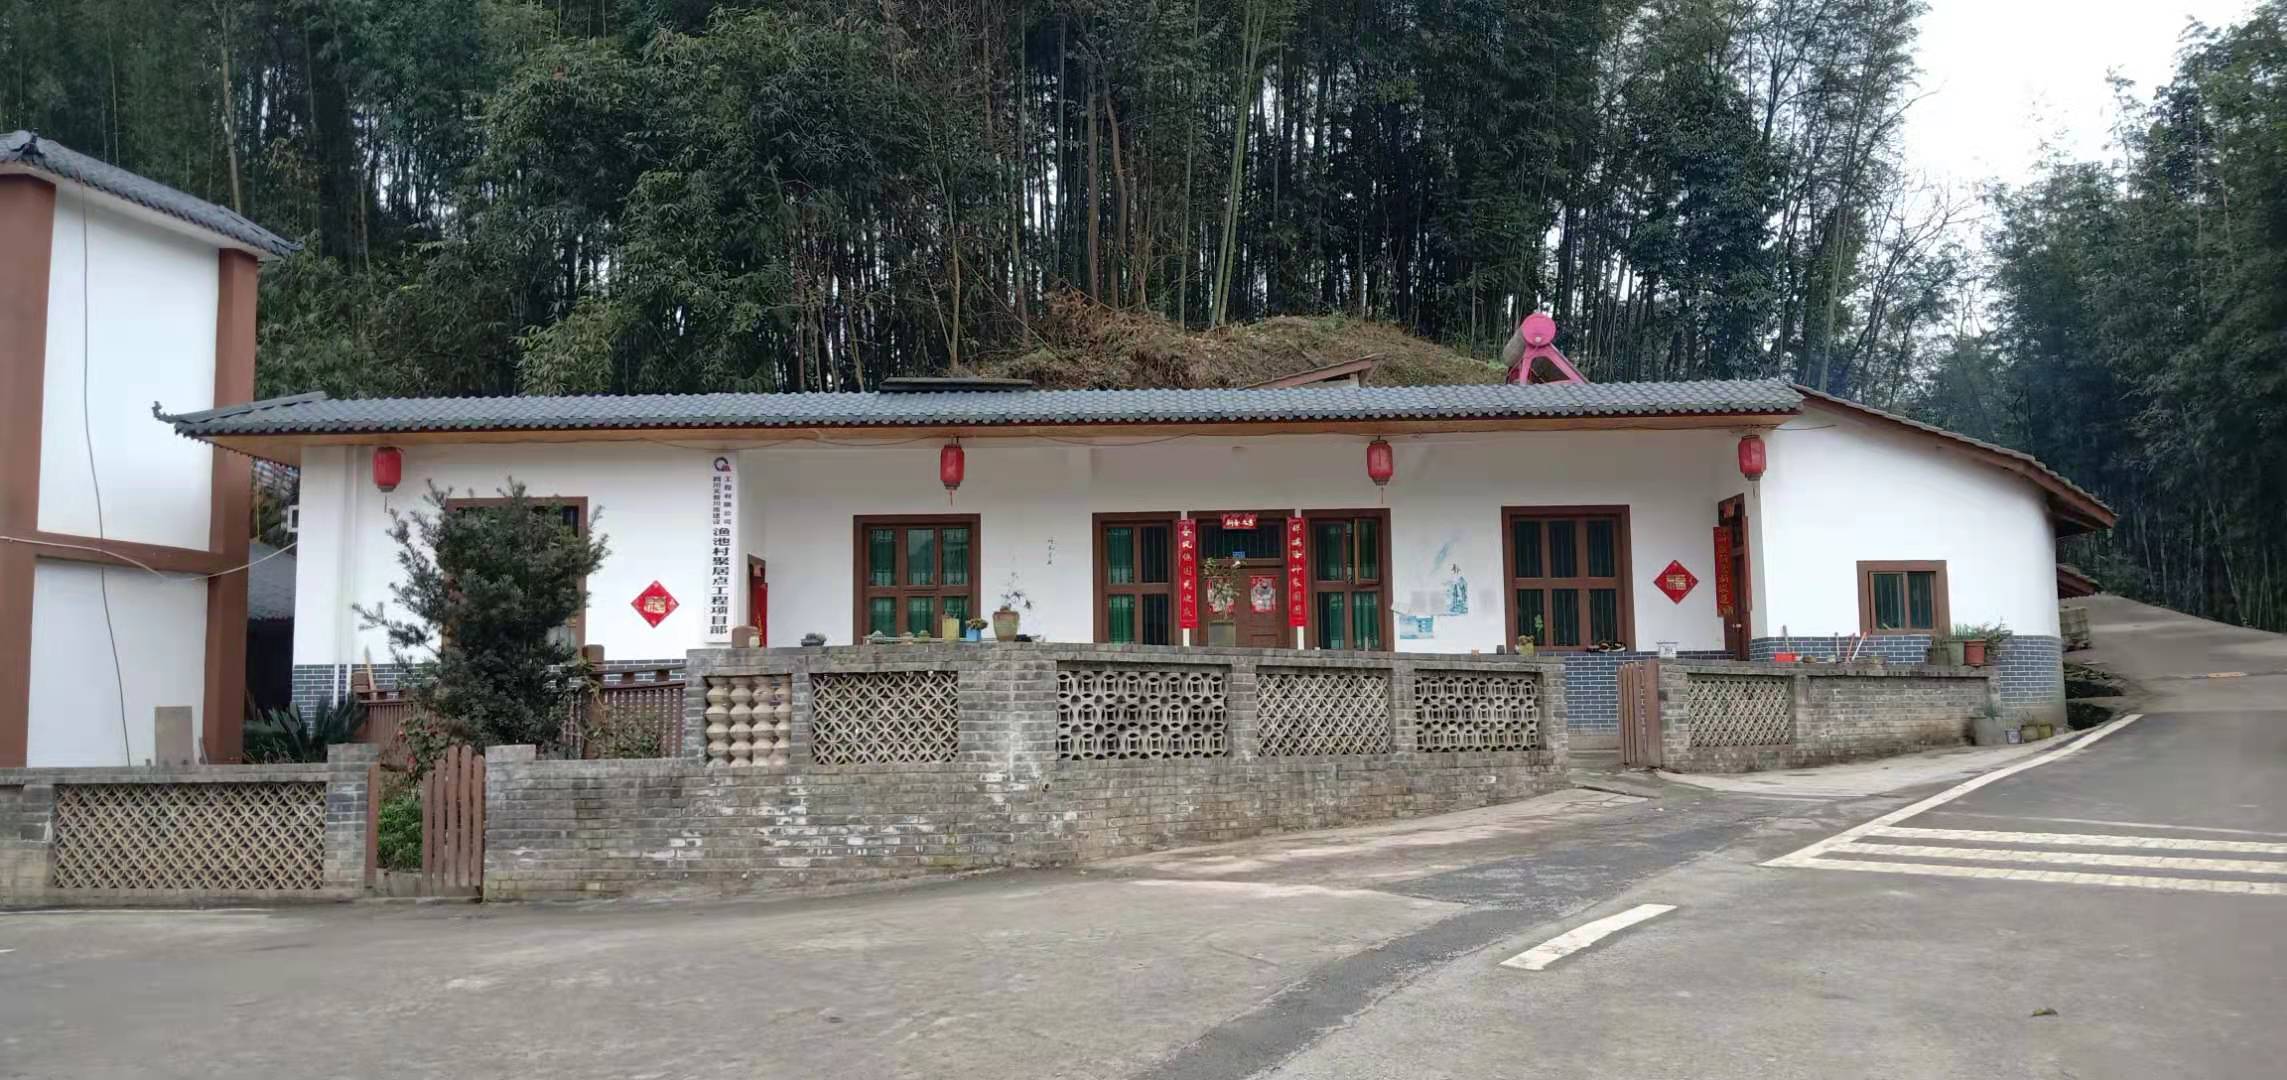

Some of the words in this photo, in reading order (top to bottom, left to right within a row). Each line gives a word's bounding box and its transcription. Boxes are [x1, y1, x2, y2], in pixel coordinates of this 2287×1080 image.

[710, 527, 730, 634] 渔池村聚居点工程项目部
